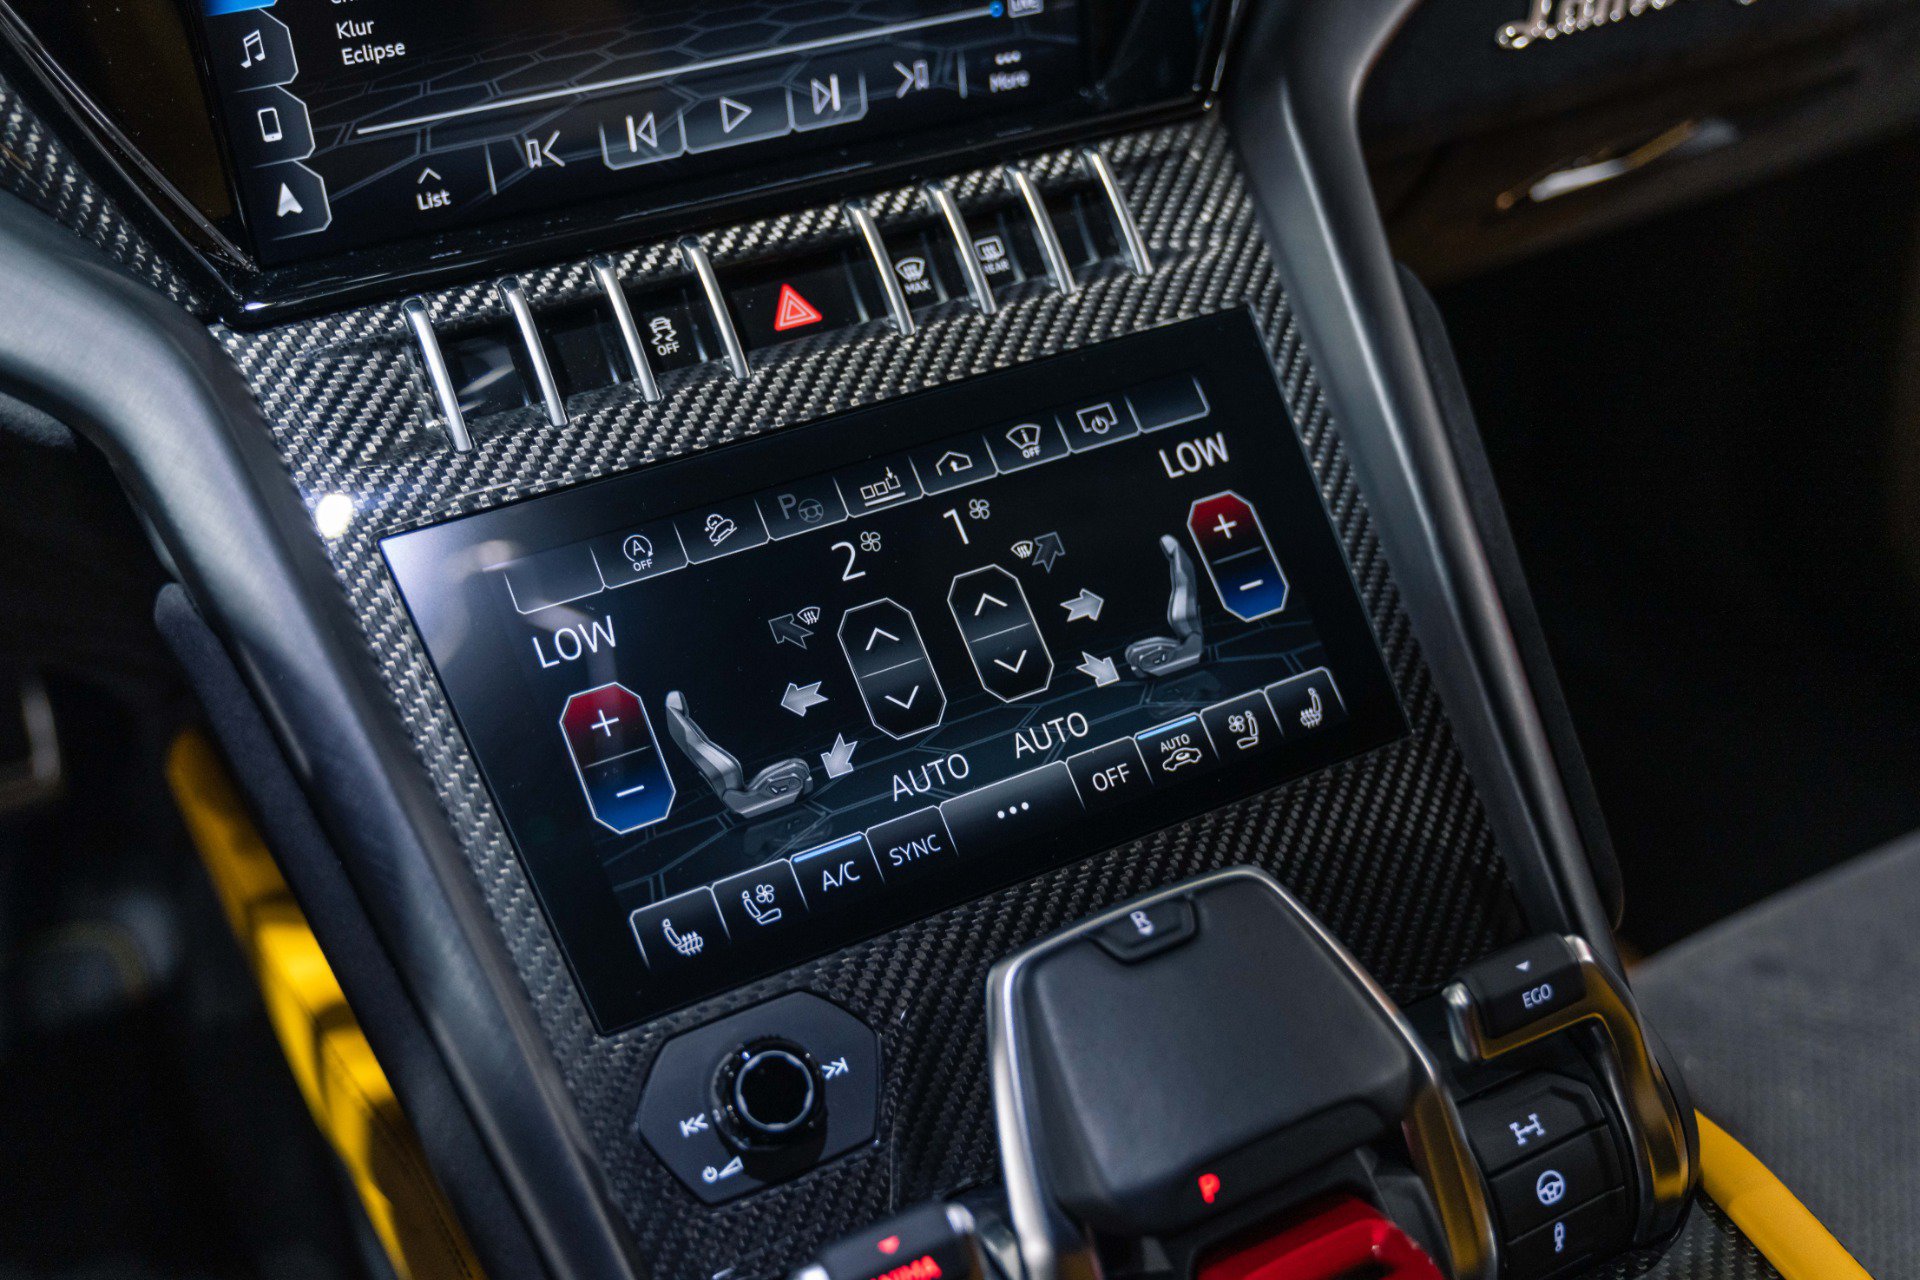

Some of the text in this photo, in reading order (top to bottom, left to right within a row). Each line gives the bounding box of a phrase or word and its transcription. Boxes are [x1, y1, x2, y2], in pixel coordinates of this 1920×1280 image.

[335, 19, 375, 40] Klur
[341, 42, 406, 66] Eclipse
[988, 69, 1031, 94] More
[416, 188, 452, 211] List
[903, 278, 932, 295] MAX
[656, 340, 681, 356] OFF
[1021, 444, 1041, 459] OFF
[1158, 431, 1229, 479] LOW
[777, 493, 797, 521] P
[943, 508, 972, 545] 1
[632, 539, 646, 556] A
[831, 540, 868, 582] 2
[632, 558, 653, 572] OFF
[530, 613, 617, 670] LOW
[1014, 711, 1091, 760] AUTO
[1158, 732, 1192, 754] AUTO
[892, 752, 971, 803] AUTO
[1091, 762, 1131, 792] OFF
[888, 833, 942, 867] SYNC
[821, 859, 862, 892] A/C
[1521, 983, 1553, 1009] EGO
[1198, 1173, 1221, 1204] P
